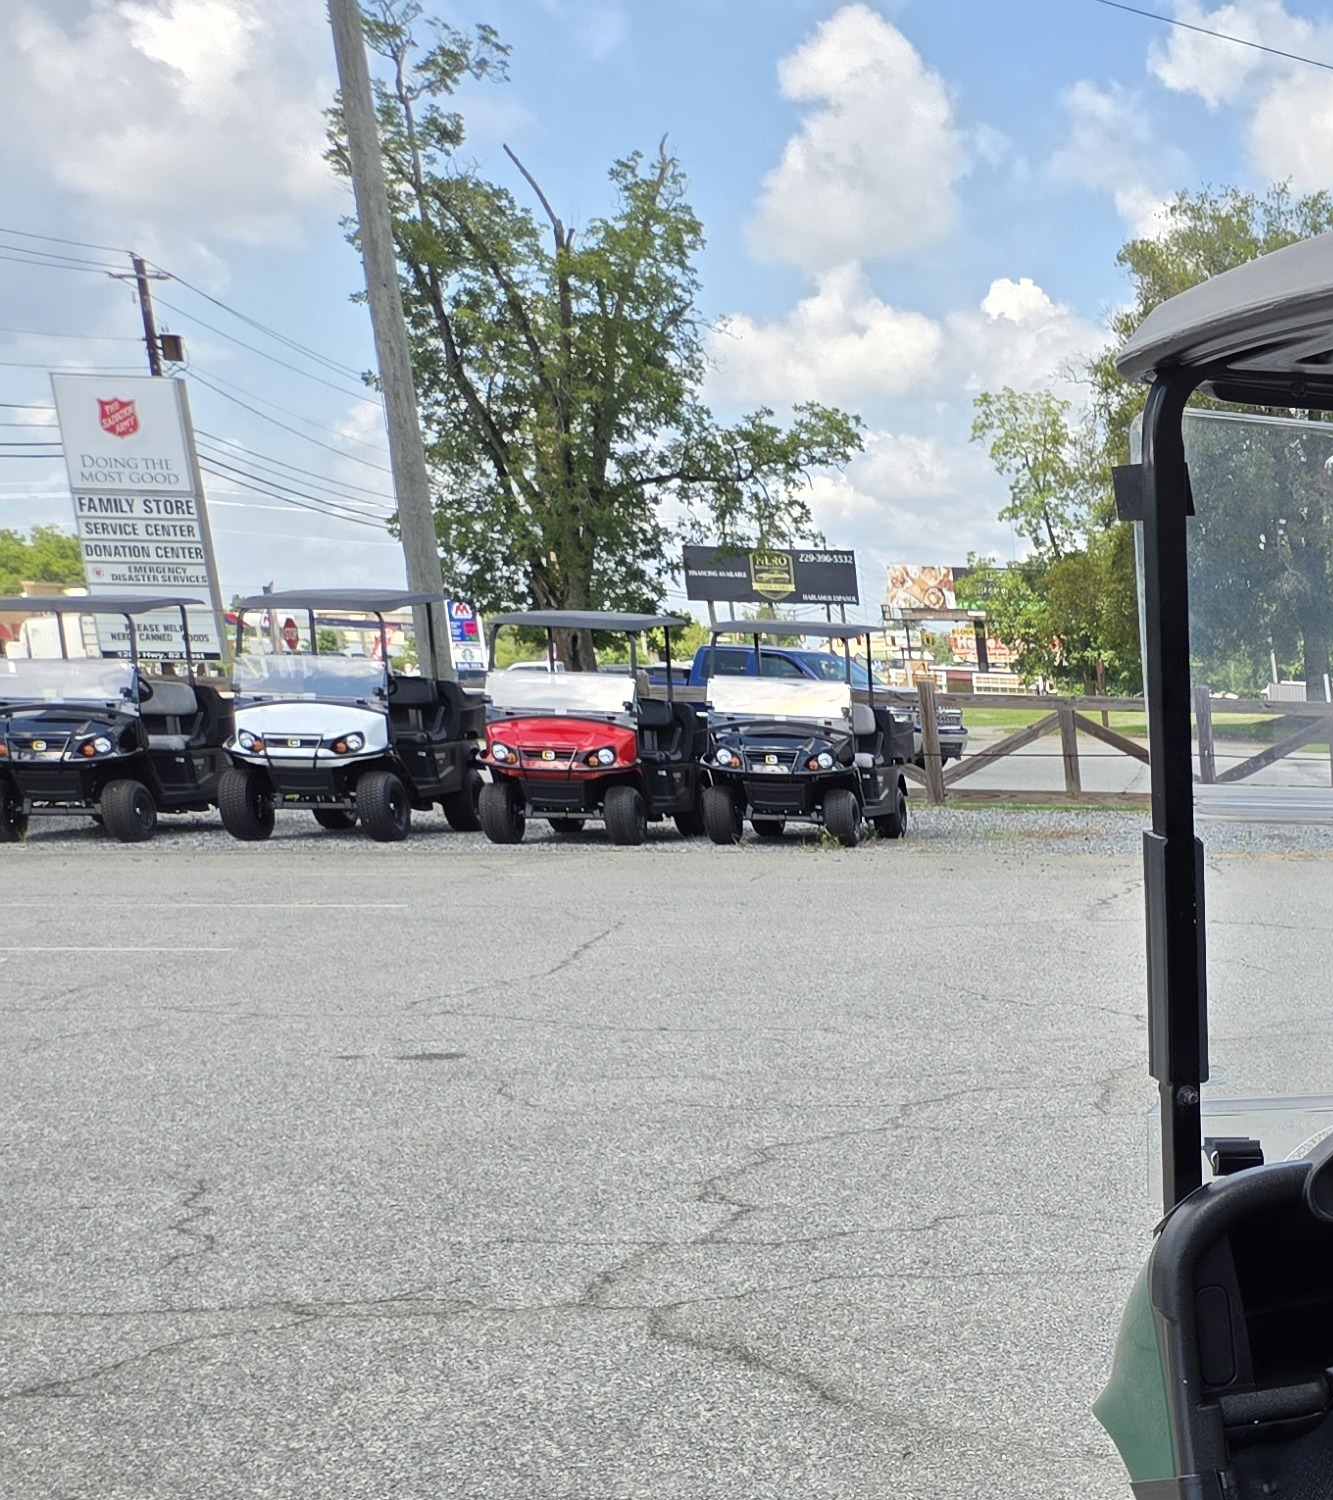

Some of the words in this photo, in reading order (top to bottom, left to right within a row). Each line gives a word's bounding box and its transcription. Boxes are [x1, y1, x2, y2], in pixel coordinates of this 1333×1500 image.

[81, 455, 138, 470] DOING
[141, 458, 173, 471] THE
[81, 472, 124, 483] MOST
[129, 473, 179, 485] GOOD
[77, 497, 134, 514] FAMILY
[143, 499, 195, 516] STORE
[85, 522, 140, 536] SERVICE
[145, 523, 196, 538] CENTER
[85, 544, 151, 559] DONATION
[155, 546, 204, 560] CENTER
[128, 565, 187, 574] EMERGENCY
[111, 574, 159, 583] DISASTER
[161, 574, 208, 583] SERVICES
[125, 624, 160, 632] PEASE
[139, 633, 173, 642] CANNED
